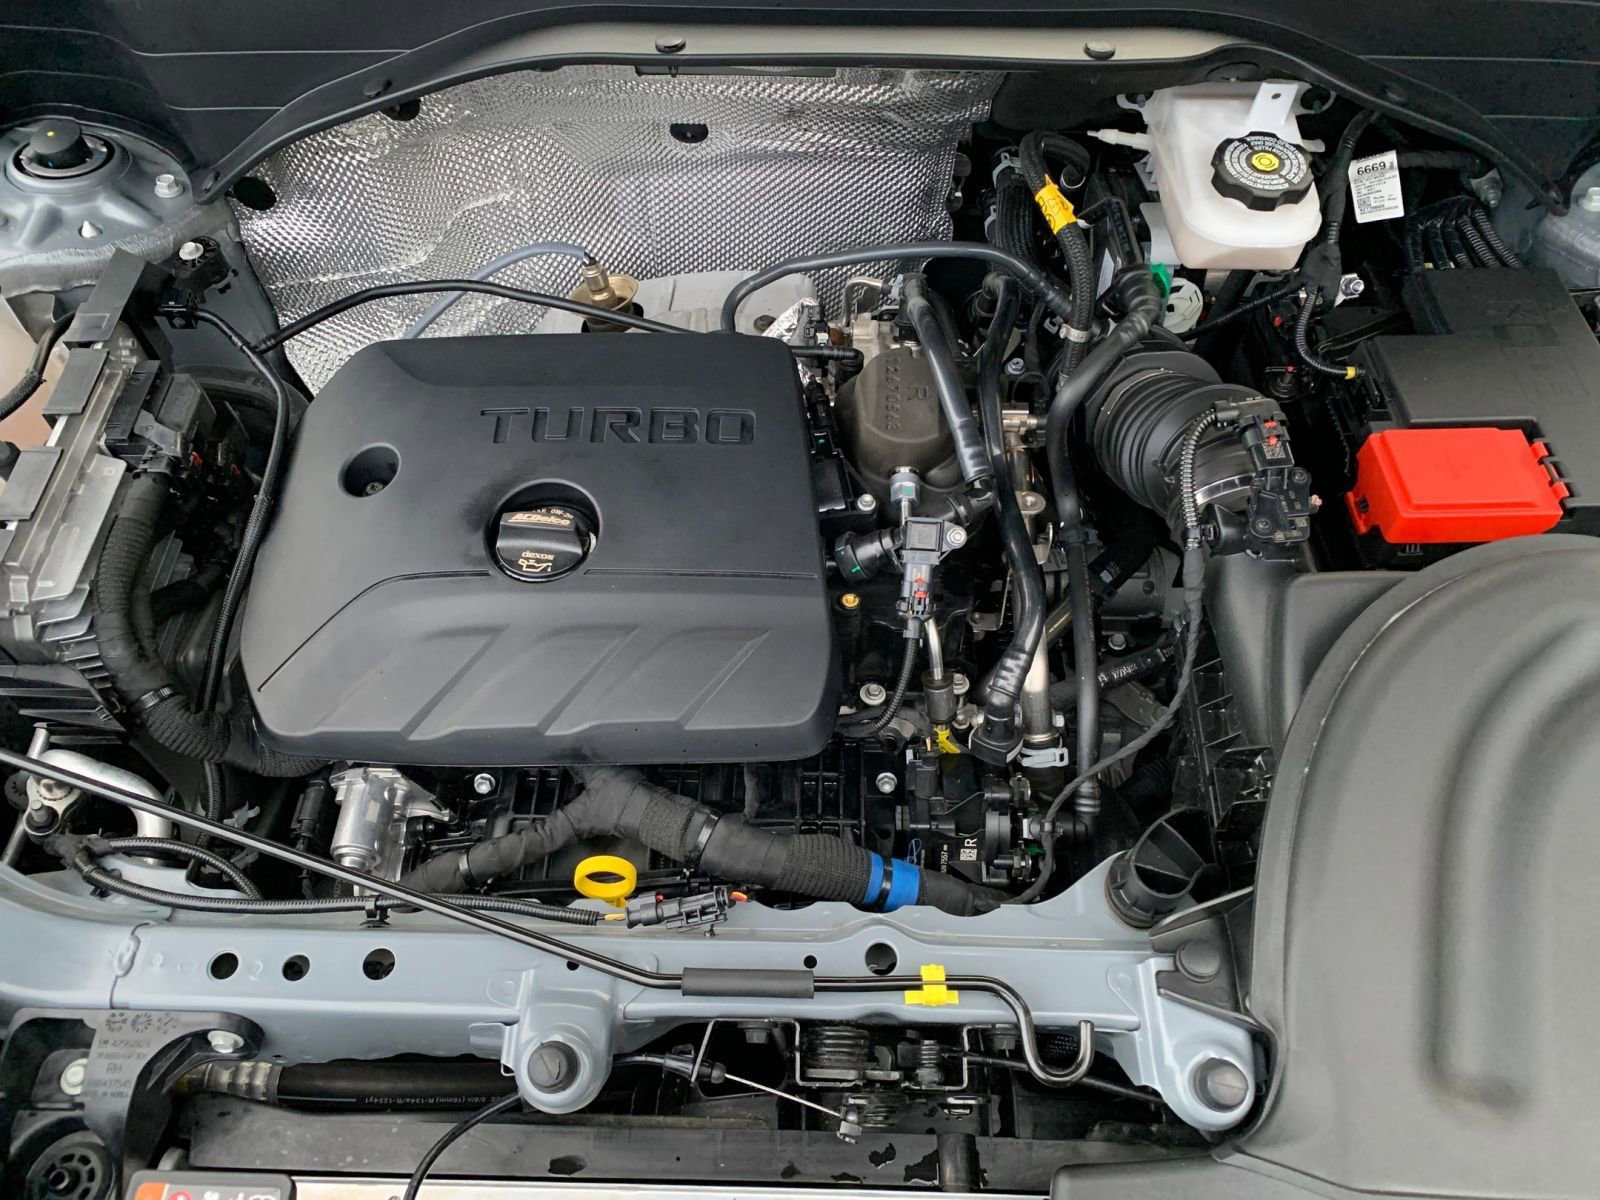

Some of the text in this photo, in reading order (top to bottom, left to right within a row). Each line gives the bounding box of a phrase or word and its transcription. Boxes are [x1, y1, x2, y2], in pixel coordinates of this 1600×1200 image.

[1356, 161, 1387, 176] 6669
[480, 407, 757, 444] TURBO
[507, 513, 571, 526] ACDelco
[521, 550, 555, 561] dexos
[964, 838, 978, 847] R
[106, 1062, 123, 1074] RH
